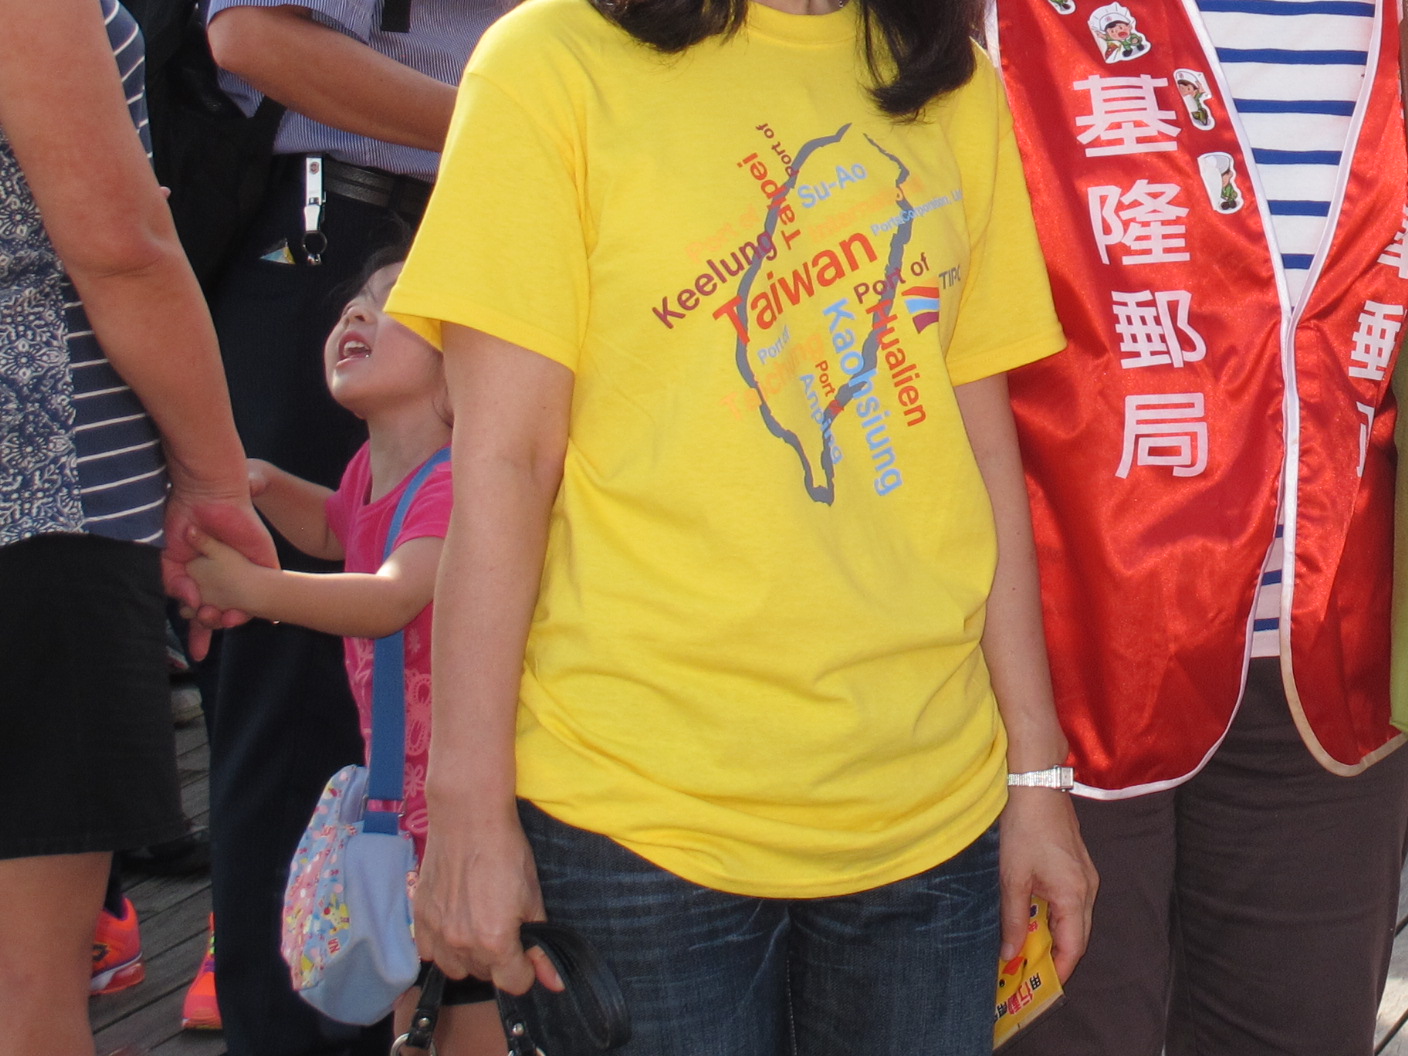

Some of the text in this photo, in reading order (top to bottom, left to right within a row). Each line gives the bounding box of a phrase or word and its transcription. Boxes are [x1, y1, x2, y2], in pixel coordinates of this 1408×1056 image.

[755, 122, 799, 178] Port of
[797, 163, 868, 209] Su-Ao
[737, 152, 801, 251] Taipei
[652, 230, 778, 330] Keelung
[712, 232, 878, 346] Taiwan
[853, 252, 930, 304] Port of
[1072, 73, 1208, 480] 基隆郵局
[815, 360, 836, 397] Port
[822, 297, 903, 496] Kaohsiung
[865, 298, 927, 428] Hualien
